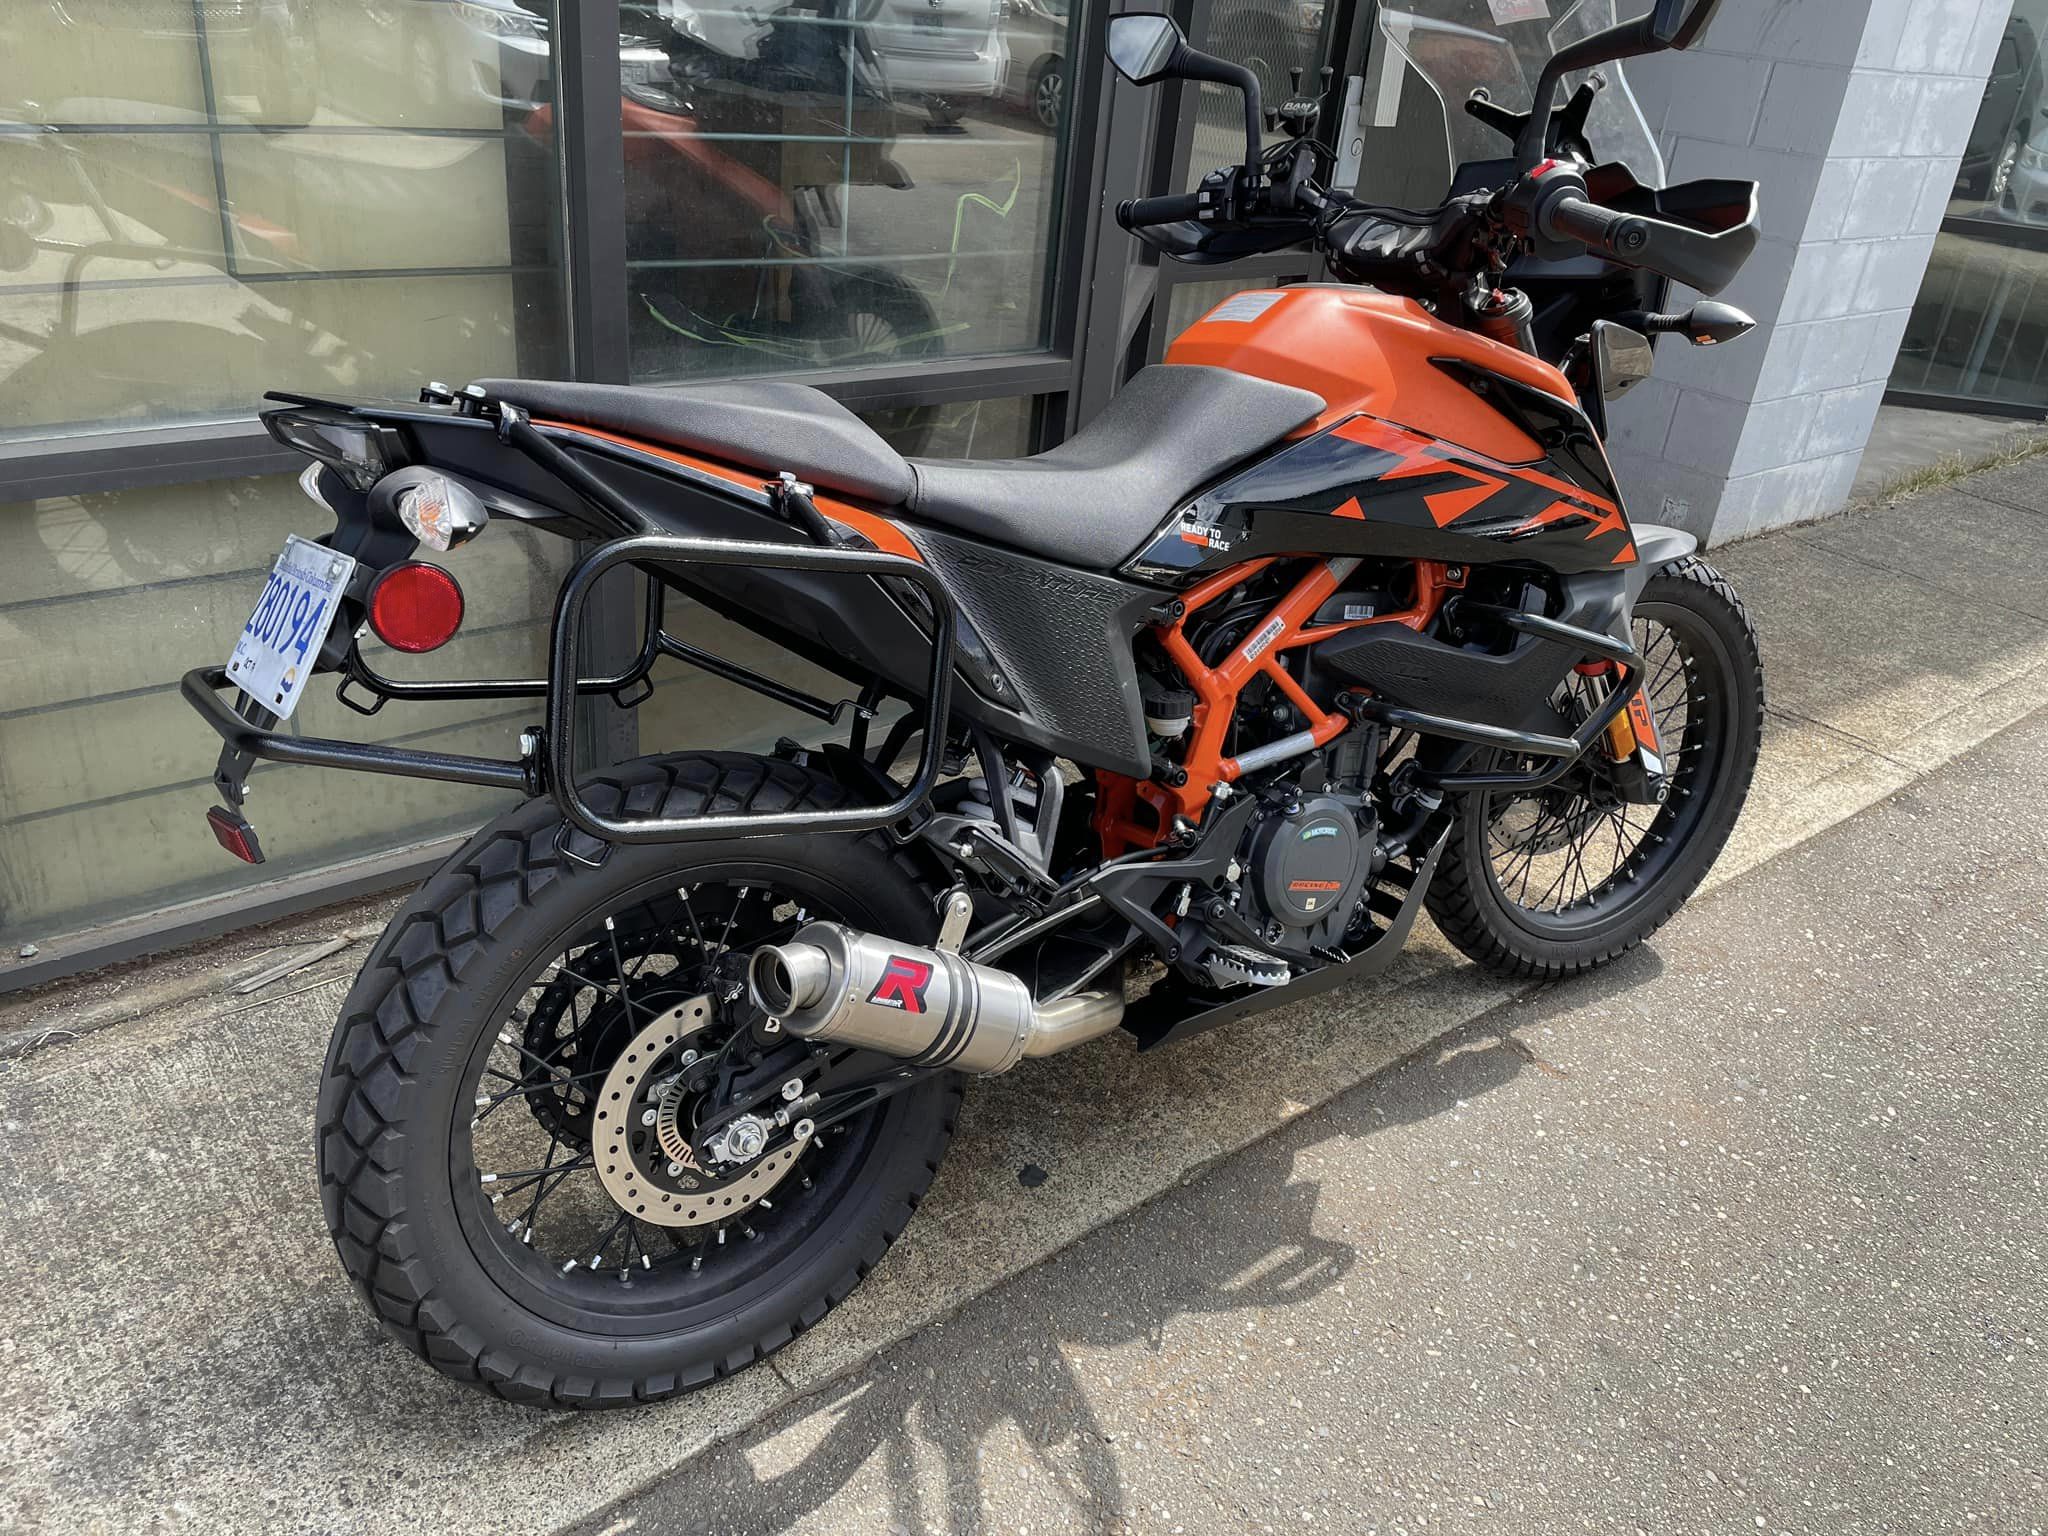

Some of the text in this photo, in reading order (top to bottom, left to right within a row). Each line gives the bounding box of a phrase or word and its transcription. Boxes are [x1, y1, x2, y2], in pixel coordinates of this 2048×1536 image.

[1181, 521, 1222, 540] READY TO
[1208, 538, 1230, 552] RACE
[245, 573, 327, 665] Z80194
